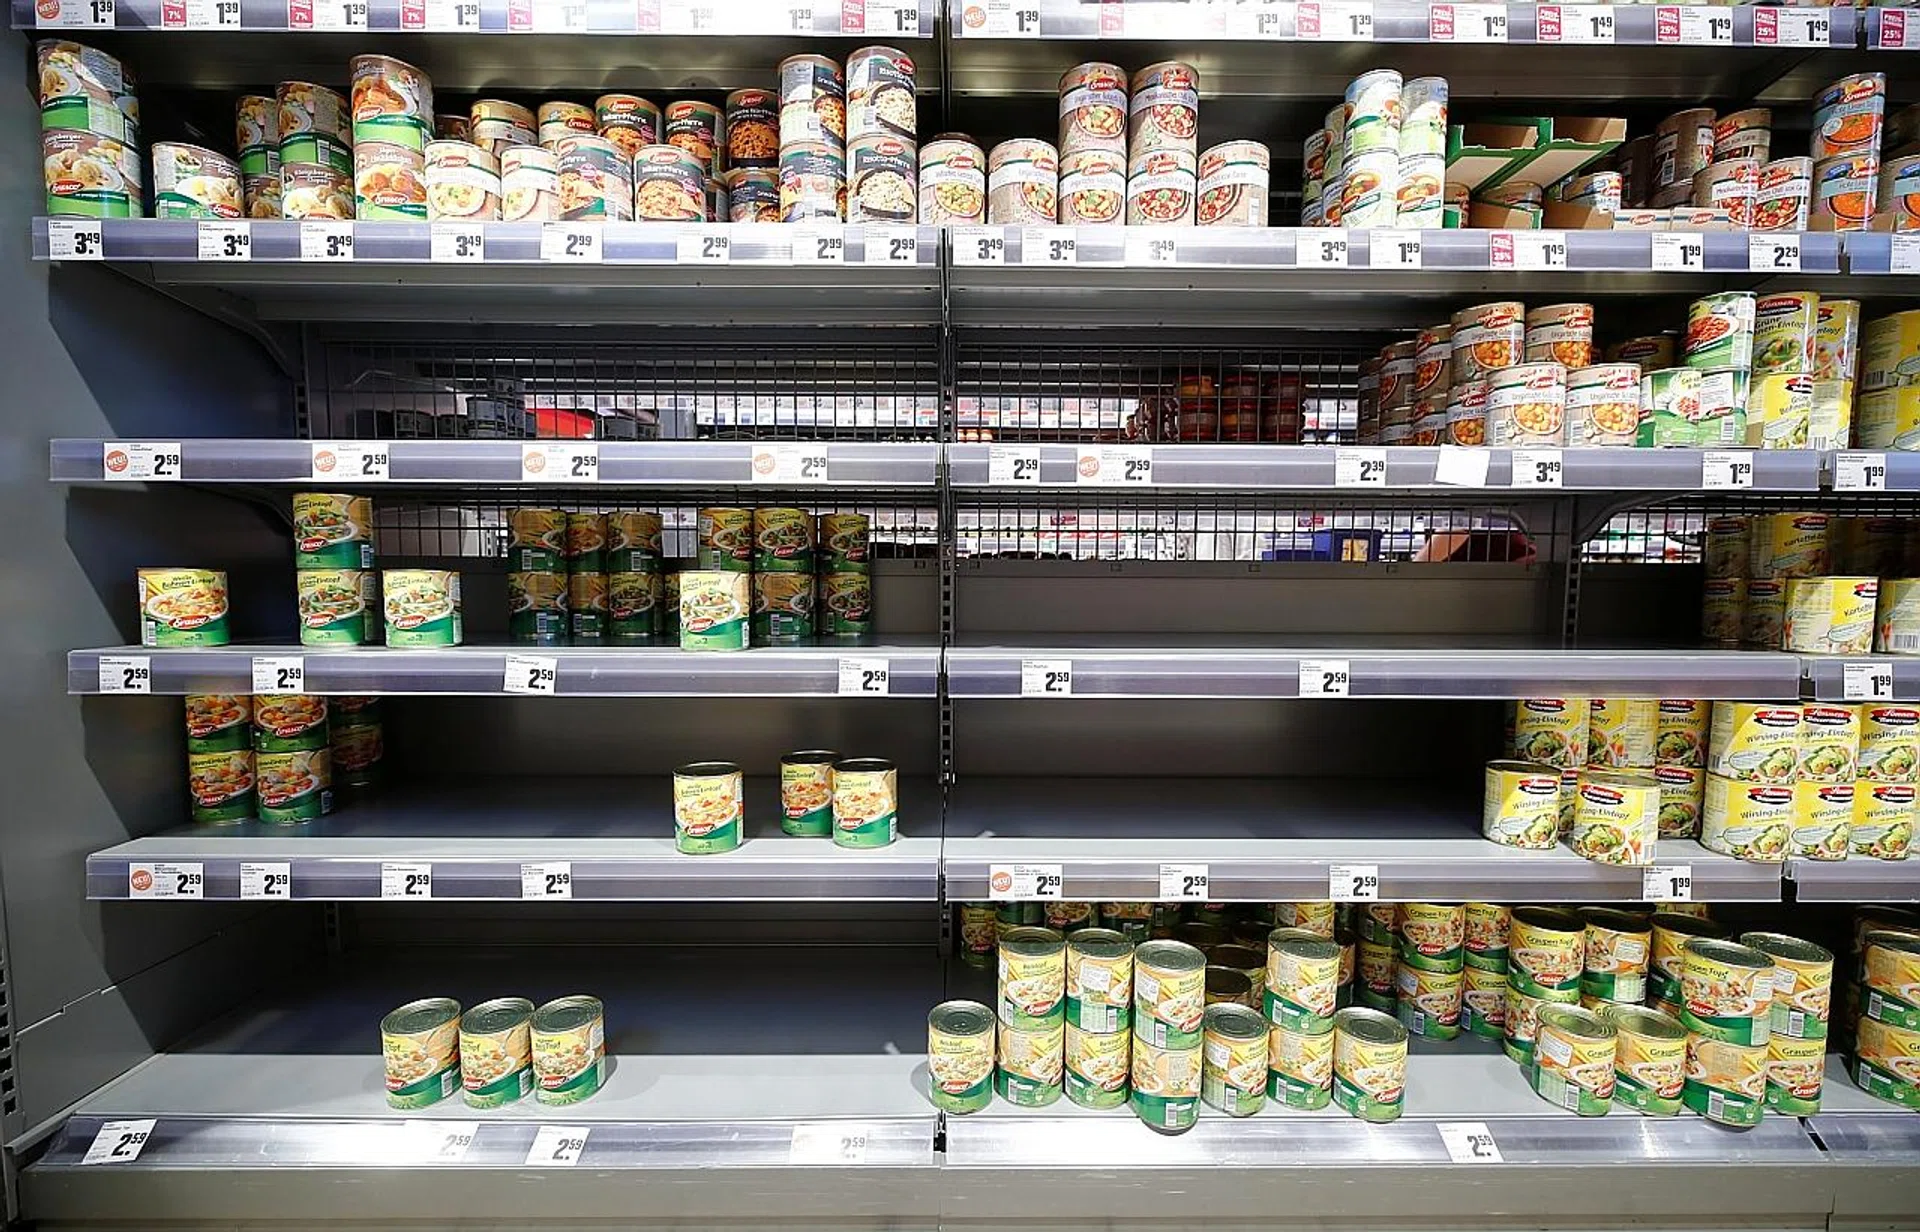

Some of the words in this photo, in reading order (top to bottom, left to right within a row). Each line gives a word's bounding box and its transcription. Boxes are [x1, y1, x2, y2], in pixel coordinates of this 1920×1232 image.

[91, 1, 113, 23] 1.39
[216, 2, 238, 24] 1.39
[343, 4, 366, 25] 1.39
[455, 5, 477, 26] 1.39
[894, 9, 917, 31] 1.39
[1016, 10, 1038, 32] 1.39
[1350, 15, 1371, 35] 1.39
[1484, 17, 1505, 37] 1.49
[1540, 24, 1558, 33] 25%
[1590, 17, 1612, 37] 1.49
[1659, 25, 1678, 35] 25%
[1709, 18, 1731, 39] 1.49
[1757, 27, 1776, 36] 25%
[1806, 20, 1828, 41] 1.49
[1884, 30, 1902, 39] 25%
[74, 232, 100, 254] 3.49
[224, 234, 249, 256] 3.49
[327, 236, 353, 257] 3.49
[456, 235, 481, 256] 3.49
[566, 234, 592, 256] 2.99
[702, 237, 728, 258] 2.99
[817, 238, 842, 259] 2.99
[889, 238, 915, 260] 2.99
[978, 238, 1003, 260] 3.49
[1050, 239, 1075, 261] 3.49
[1321, 241, 1346, 262] 3.49
[1398, 242, 1420, 263] 1.99
[1542, 244, 1564, 265] 1.49
[1680, 245, 1701, 266] 1.99
[1773, 246, 1798, 267] 2.29
[154, 454, 179, 475] 2.59
[362, 454, 387, 475] 2.59
[571, 455, 597, 477] 2.59
[801, 457, 826, 478] 2.59
[1013, 459, 1038, 480] 2.59
[1124, 460, 1150, 481] 2.59
[1359, 461, 1384, 481] 2.39
[1536, 461, 1561, 482] 3.49
[1729, 464, 1750, 484] 1.29
[1863, 466, 1883, 487] 1.99
[173, 617, 206, 628] Erasco
[123, 668, 148, 689] 2.59
[277, 668, 301, 689] 2.59
[528, 669, 553, 690] 2.59
[862, 671, 887, 691] 2.59
[1045, 672, 1069, 692] 2.59
[1323, 672, 1346, 692] 2.59
[1871, 676, 1891, 696] 1.99
[275, 725, 304, 734] Erasco
[177, 874, 201, 894] 2.59
[264, 875, 287, 894] 2.59
[405, 874, 429, 895] 2.59
[545, 873, 569, 894] 2.59
[1036, 876, 1060, 896] 2.59
[1183, 876, 1207, 896] 2.59
[1353, 877, 1377, 897] 2.59
[1670, 878, 1690, 896] 1.99
[1418, 944, 1444, 954] Erasco
[1535, 974, 1564, 984] Erasco
[1687, 1002, 1716, 1014] Erasco
[111, 1132, 147, 1156] 2.59
[552, 1139, 583, 1160] 2.59
